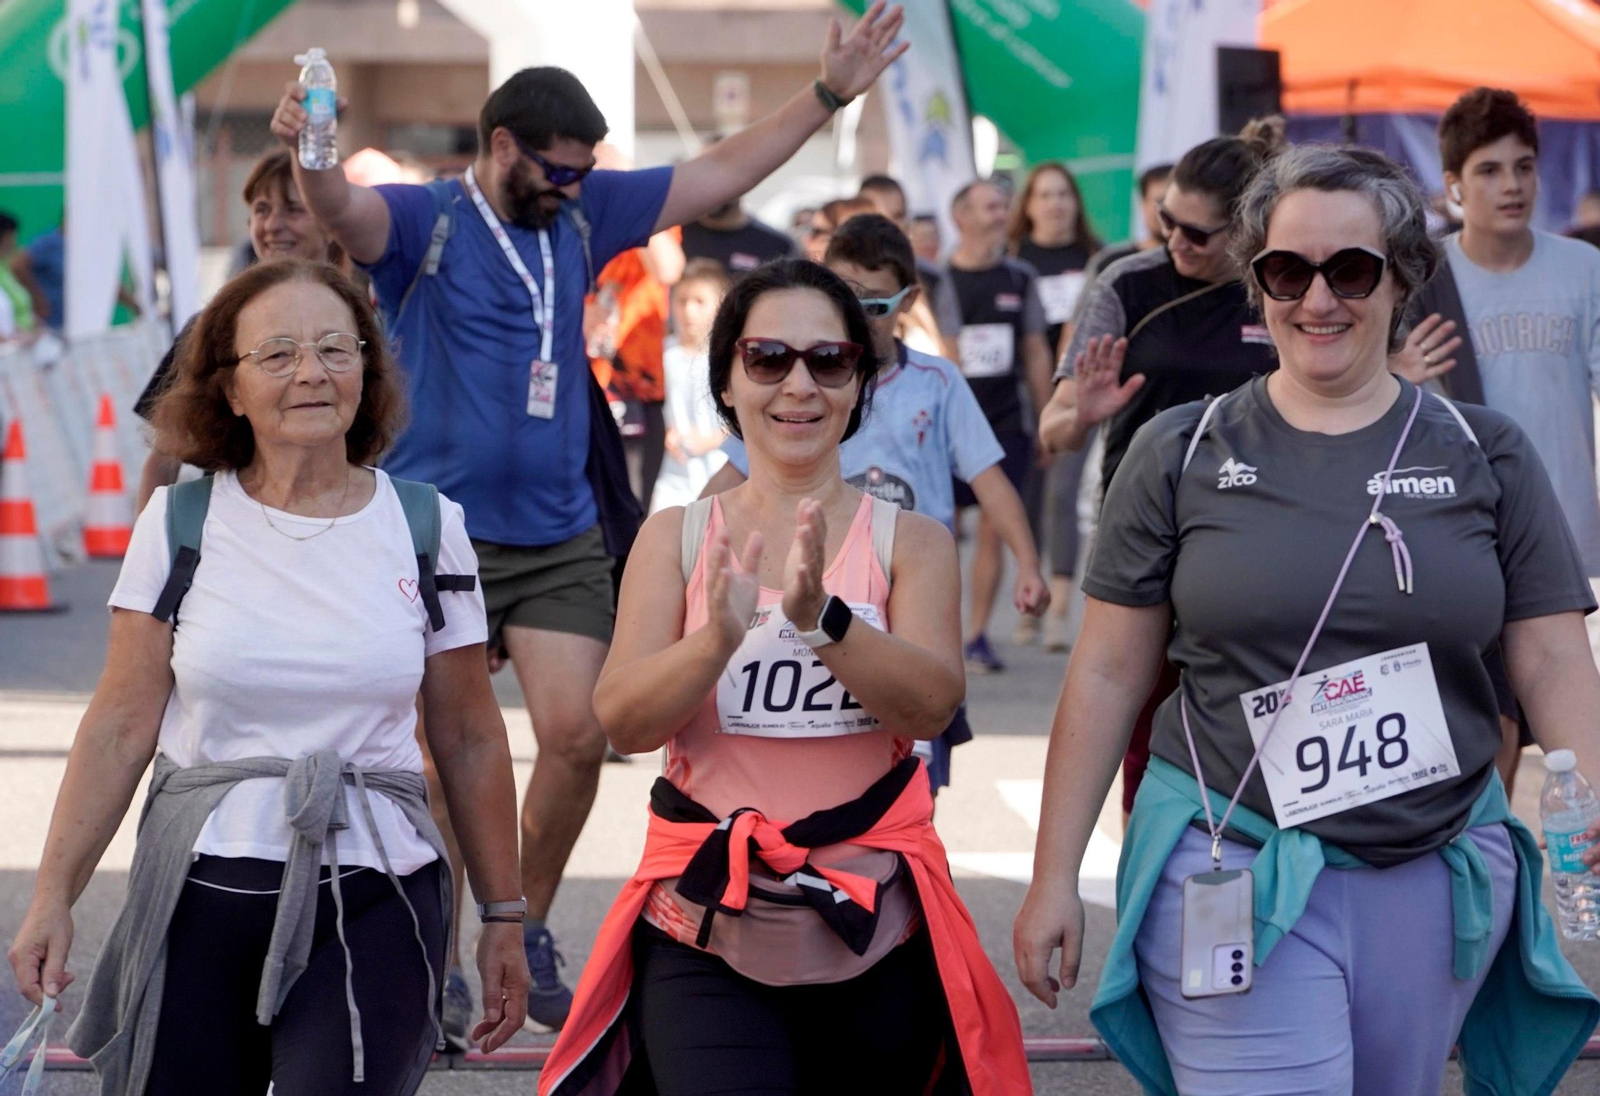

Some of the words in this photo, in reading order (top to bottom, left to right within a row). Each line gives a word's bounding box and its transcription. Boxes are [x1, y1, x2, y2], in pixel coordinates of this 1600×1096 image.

[1324, 674, 1367, 701] CAE
[1319, 716, 1345, 731] SARA
[1295, 712, 1410, 795] 948
